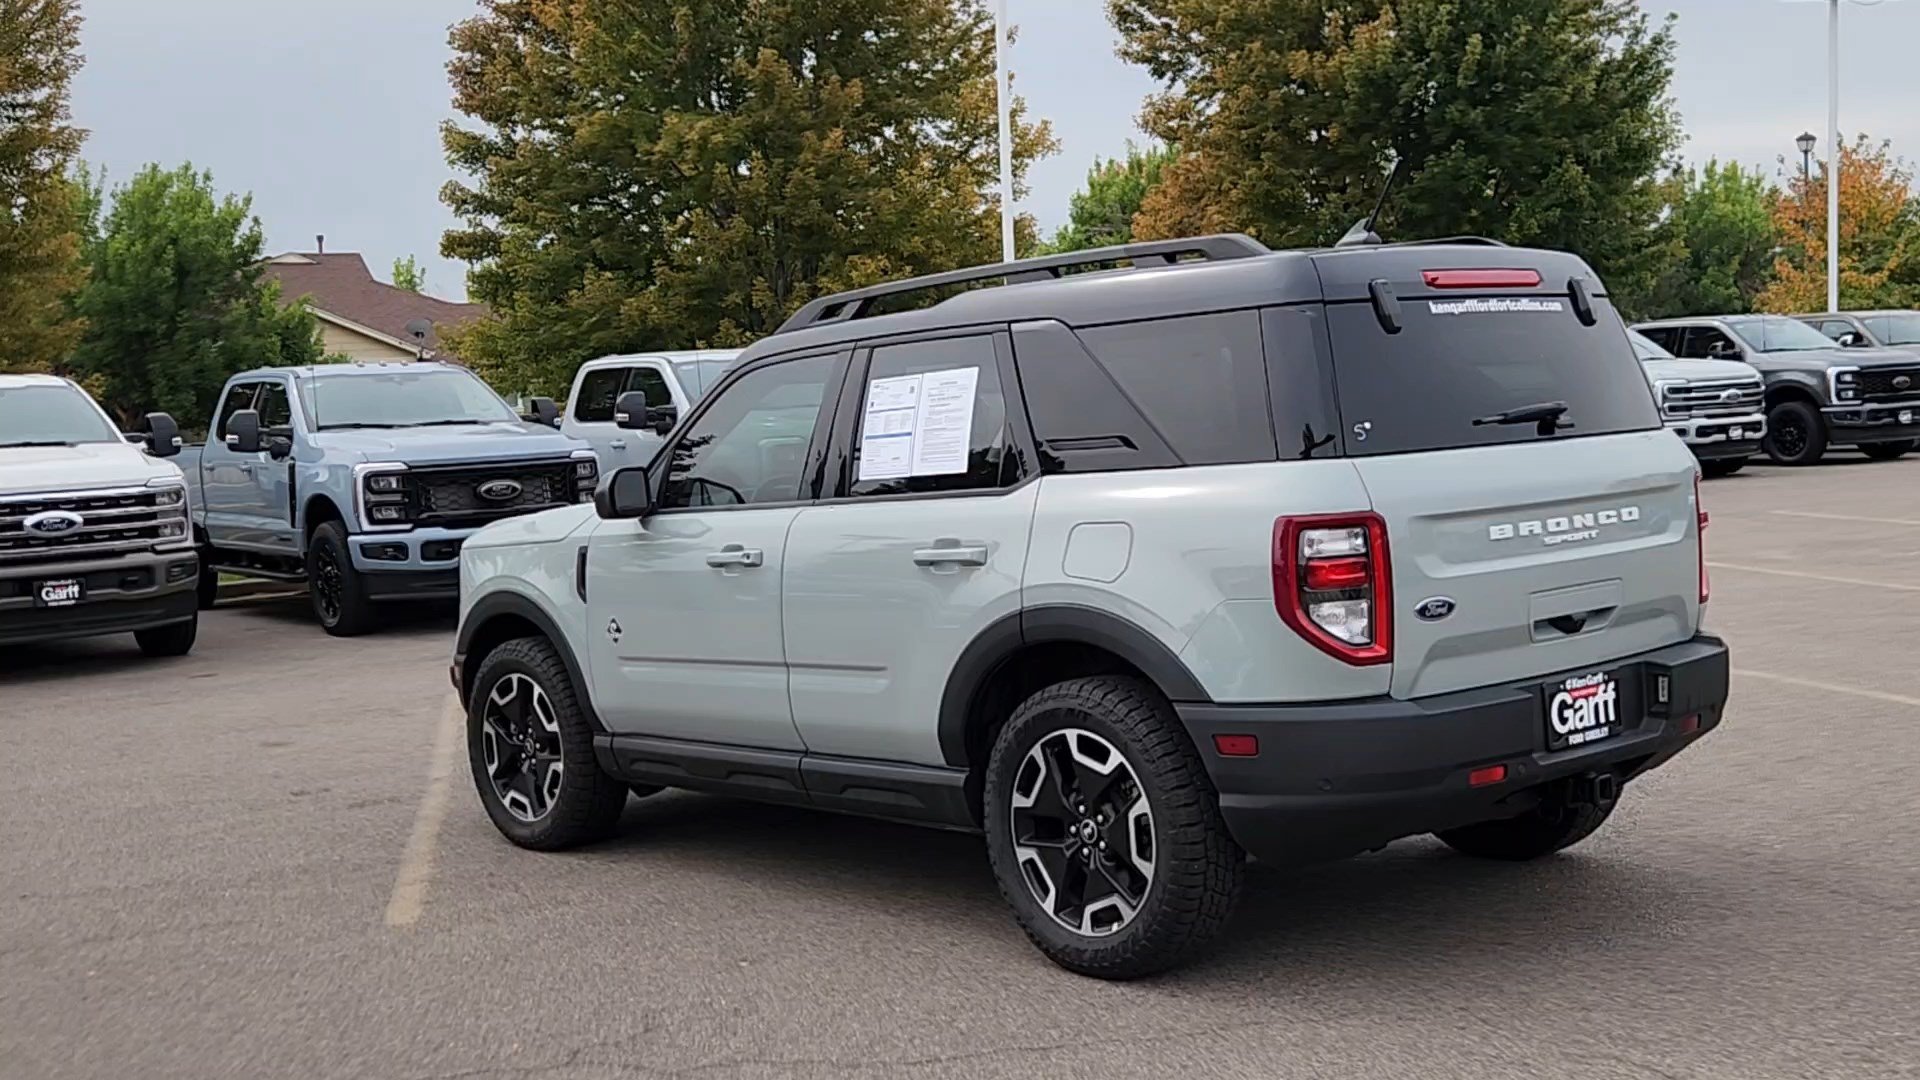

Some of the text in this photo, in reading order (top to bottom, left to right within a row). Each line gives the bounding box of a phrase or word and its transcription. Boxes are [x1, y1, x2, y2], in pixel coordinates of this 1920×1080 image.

[40, 518, 68, 531] Ford
[1488, 506, 1640, 541] BRONCO
[1543, 529, 1600, 547] SPORT
[41, 584, 80, 601] Garff
[1425, 601, 1449, 617] Ford
[1551, 681, 1616, 734] Garff
